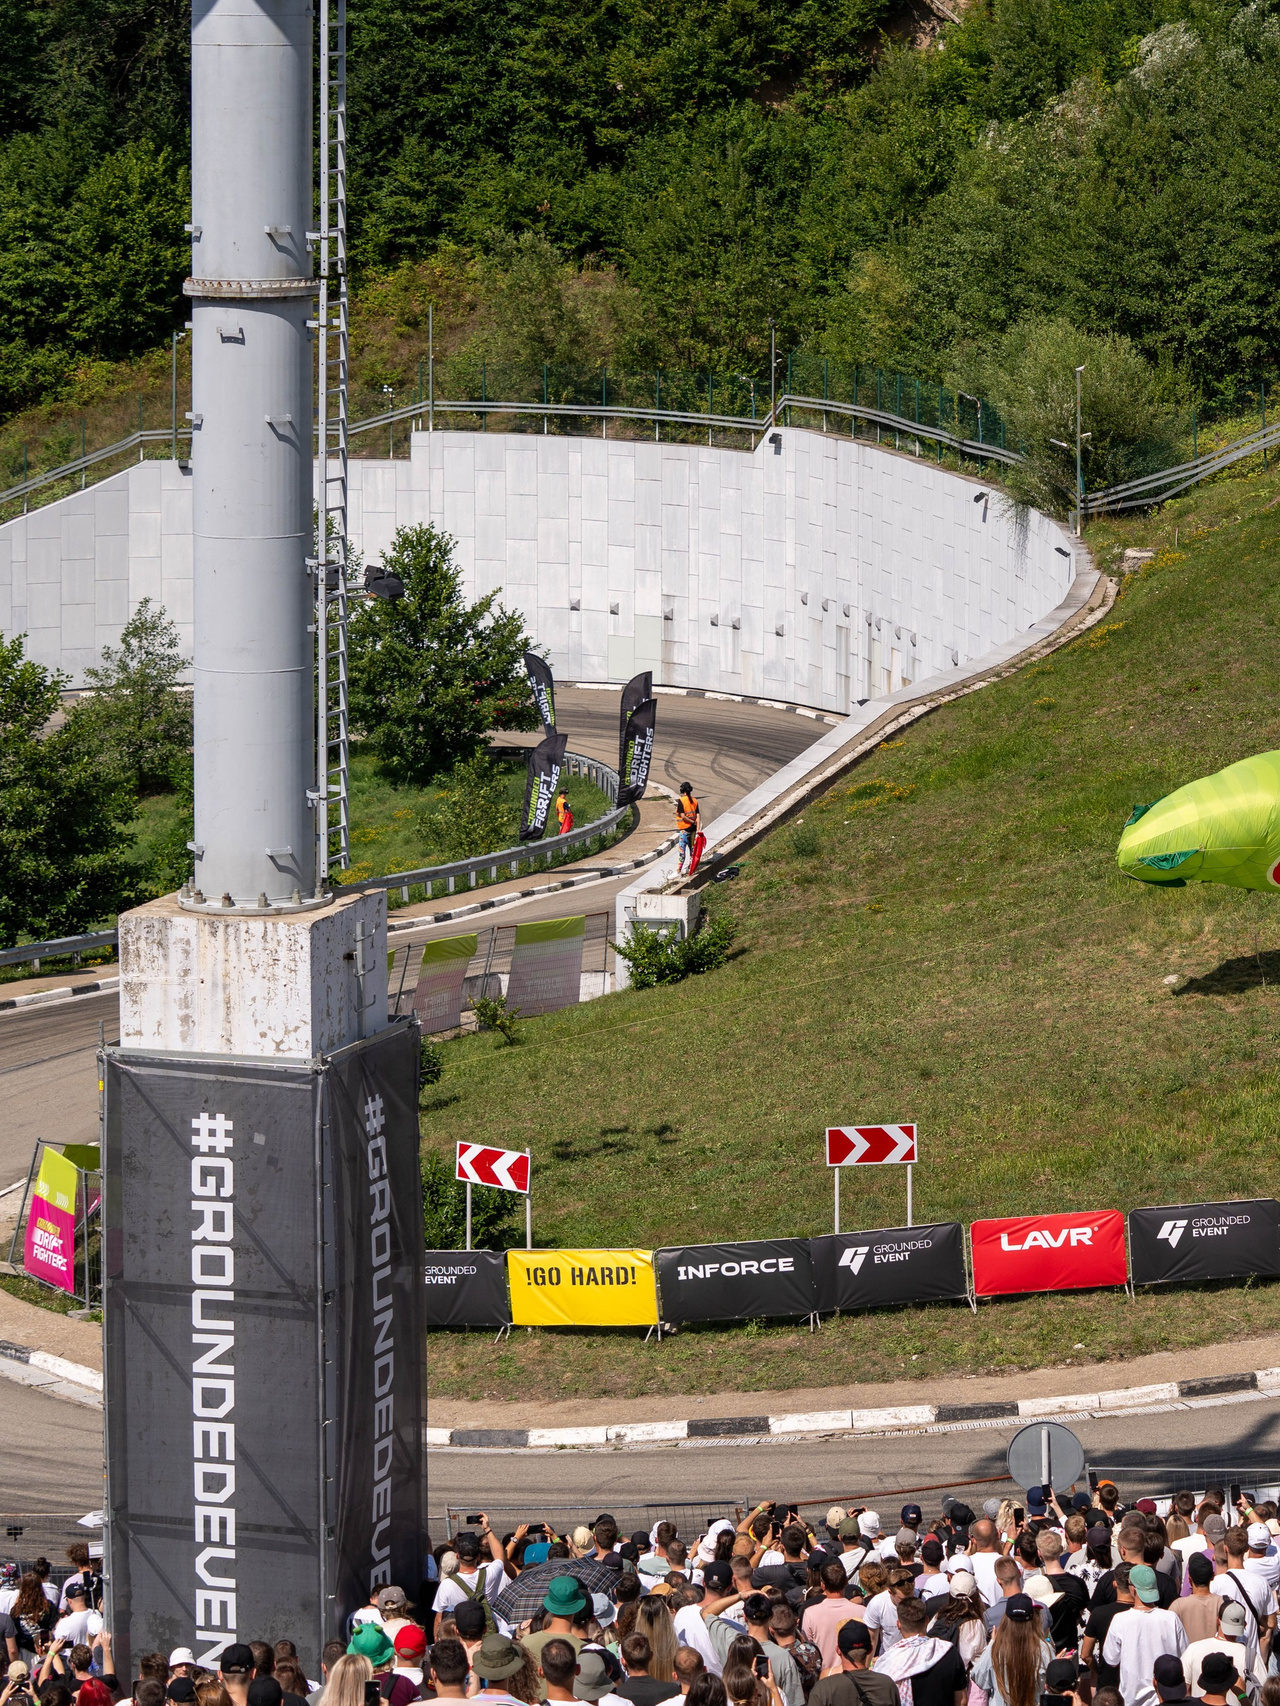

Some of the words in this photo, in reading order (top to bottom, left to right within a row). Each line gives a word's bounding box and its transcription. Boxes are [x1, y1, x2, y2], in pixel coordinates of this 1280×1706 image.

[630, 734, 646, 783] DRIFT
[636, 727, 654, 787] FIGHTERS
[527, 776, 541, 826] GROUNDED
[1191, 1215, 1251, 1229] GROUNDED
[1192, 1226, 1229, 1238] EVENT
[35, 1229, 63, 1252] DRIFT
[873, 1239, 933, 1255] GROUNDED
[1000, 1227, 1093, 1252] LAVR
[33, 1244, 67, 1271] FIGHTERS
[873, 1252, 911, 1265] EVENT
[425, 1275, 457, 1285] EVENT
[526, 1267, 561, 1287] !GO
[571, 1266, 637, 1287] HARD!
[677, 1257, 795, 1282] INFORCE
